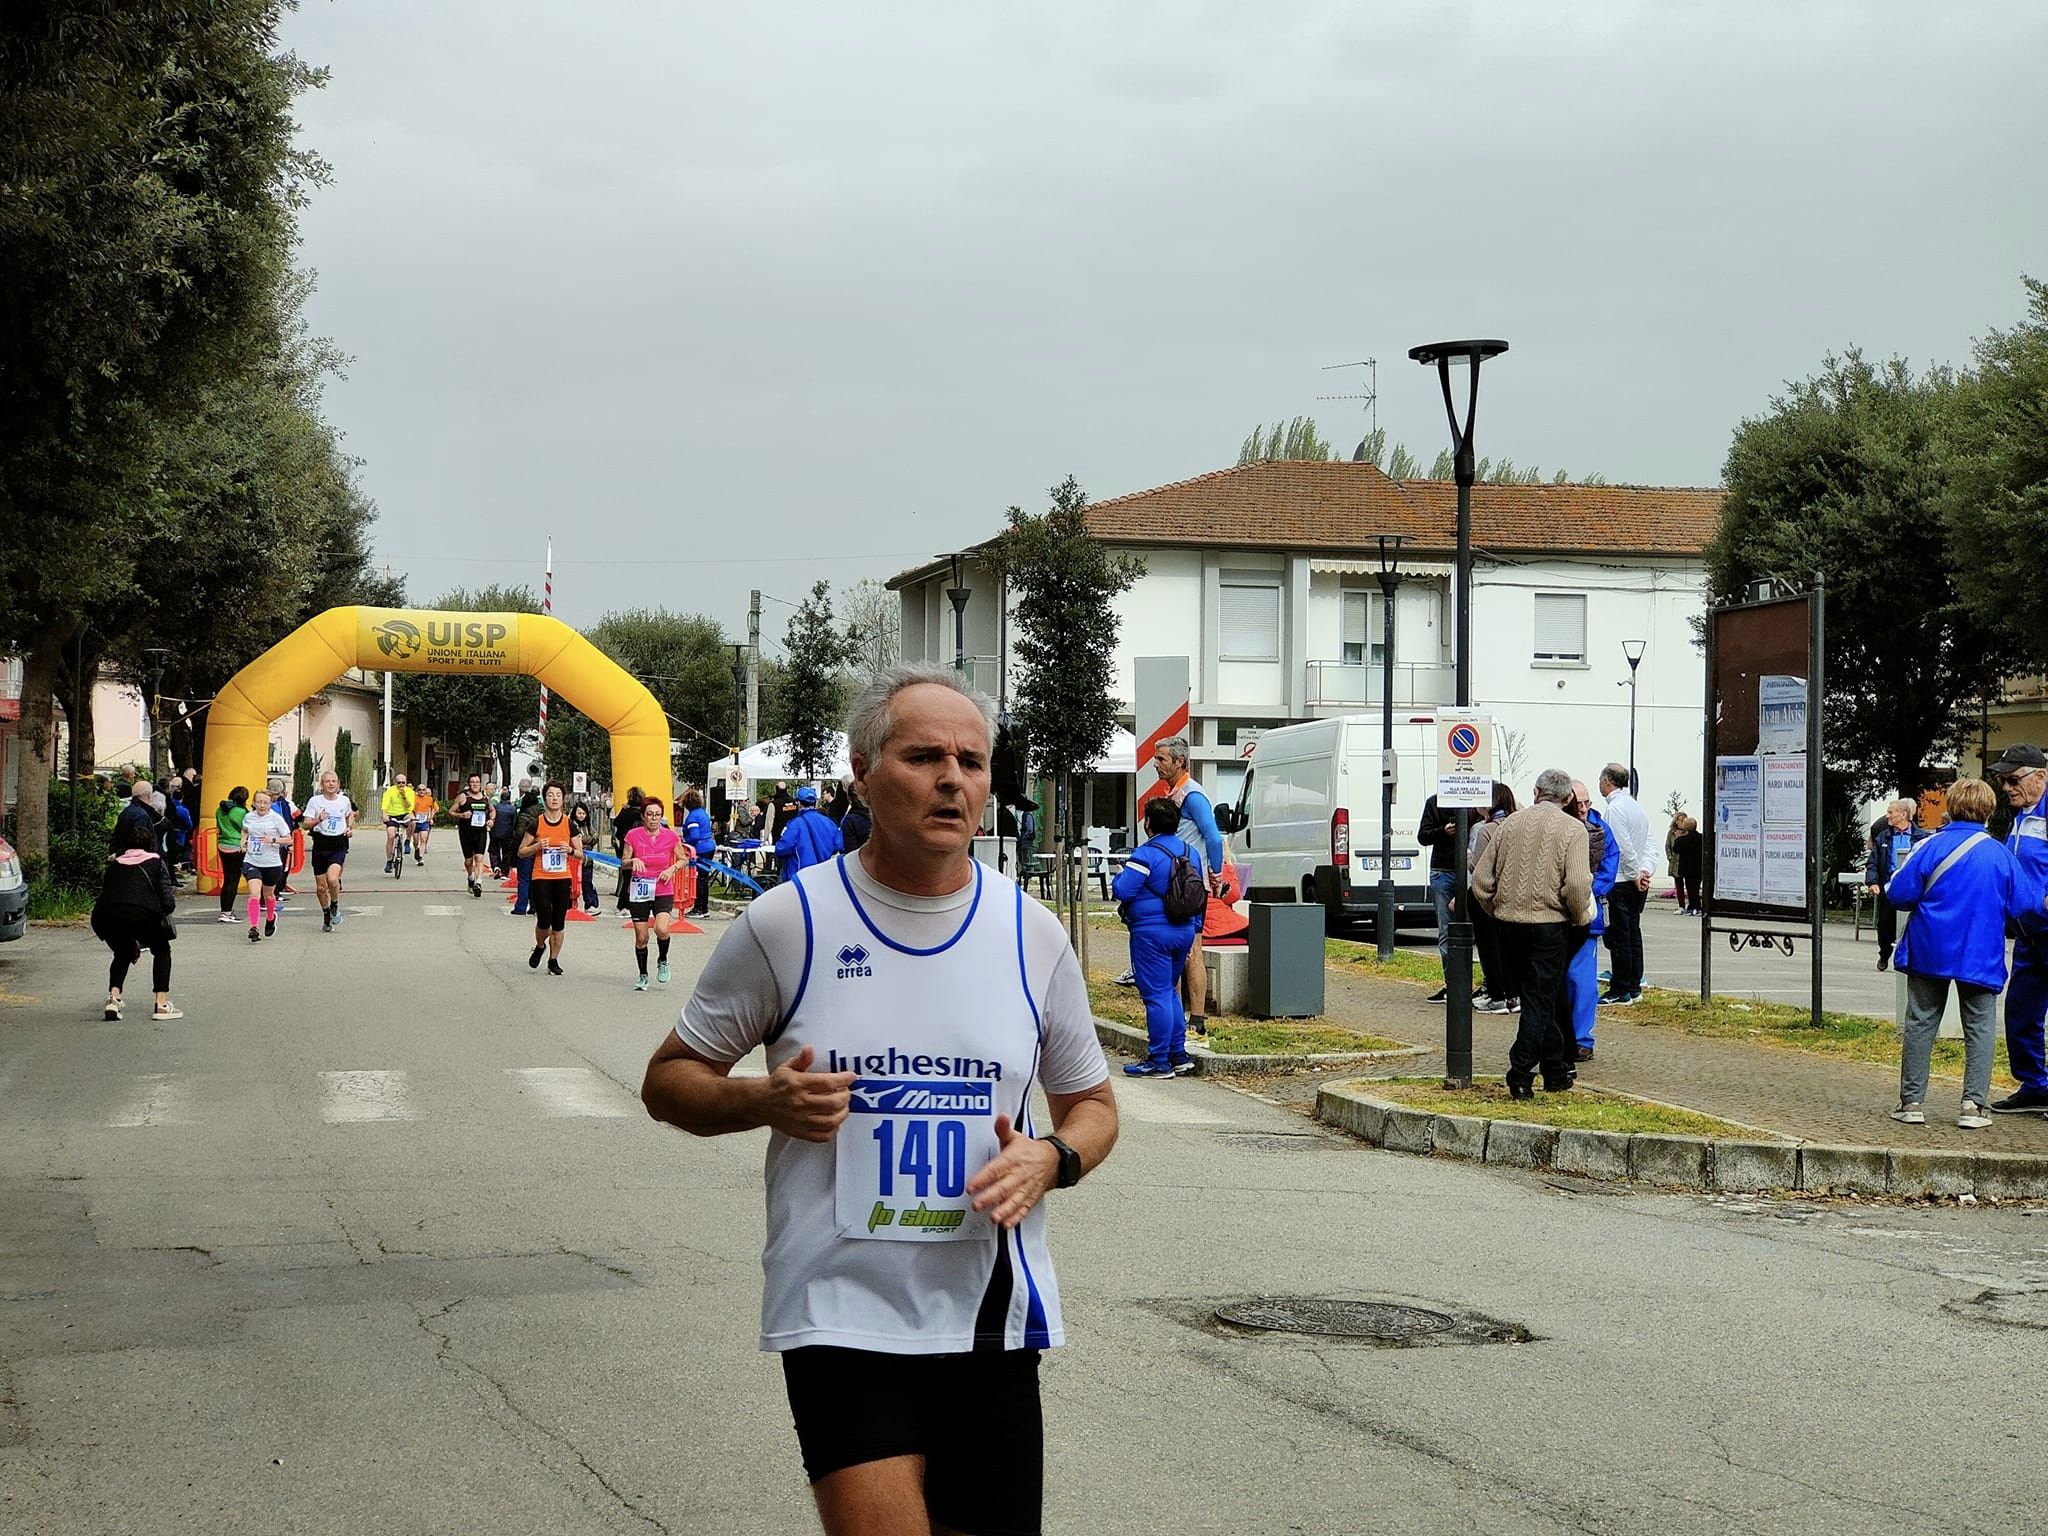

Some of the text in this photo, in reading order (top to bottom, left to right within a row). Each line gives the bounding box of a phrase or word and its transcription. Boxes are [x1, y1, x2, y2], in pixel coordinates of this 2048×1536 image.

[427, 621, 507, 648] UISP
[427, 648, 506, 659] UNIONE ITALIANA
[427, 657, 501, 667] SPORT PER TUTTI
[252, 842, 262, 852] 22
[1721, 847, 1757, 859] ALVISI IVAN
[637, 883, 649, 896] 30
[837, 965, 872, 979] errea
[829, 1047, 1002, 1081] lughesina
[873, 1119, 967, 1197] 140
